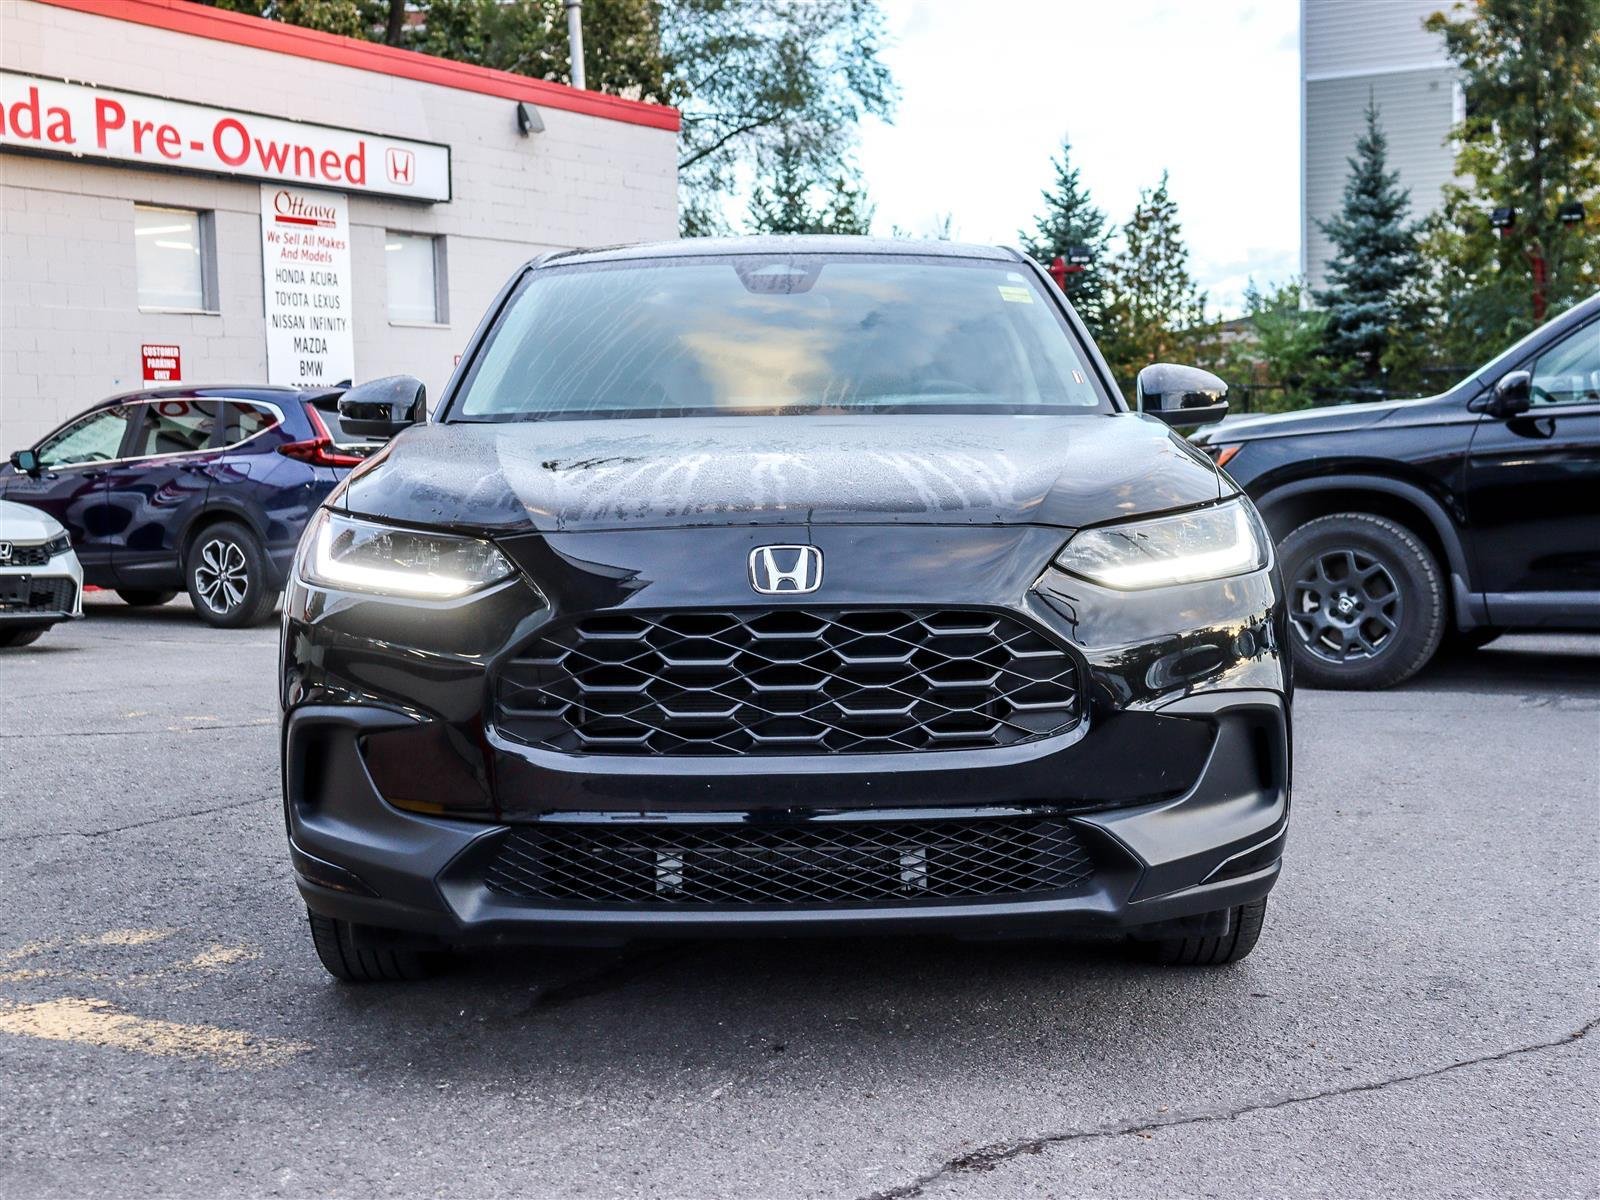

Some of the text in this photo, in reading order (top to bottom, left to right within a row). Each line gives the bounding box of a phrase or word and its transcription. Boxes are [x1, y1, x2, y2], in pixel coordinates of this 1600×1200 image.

[0, 87, 76, 144] da
[95, 97, 366, 186] Pre-Owned
[274, 190, 336, 219] Ottawa
[267, 230, 346, 250] We Sell All Makes
[281, 247, 332, 263] And Models
[275, 268, 339, 287] HONDA ACURA
[275, 291, 341, 309] TOYOTA LEXUS
[272, 313, 346, 332] NISSAN INFINITY
[143, 346, 179, 357] CUSTOMER
[293, 337, 328, 354] MAZDA
[147, 358, 176, 369] PARKING
[299, 360, 323, 376] BMW
[154, 370, 170, 380] ONLY
